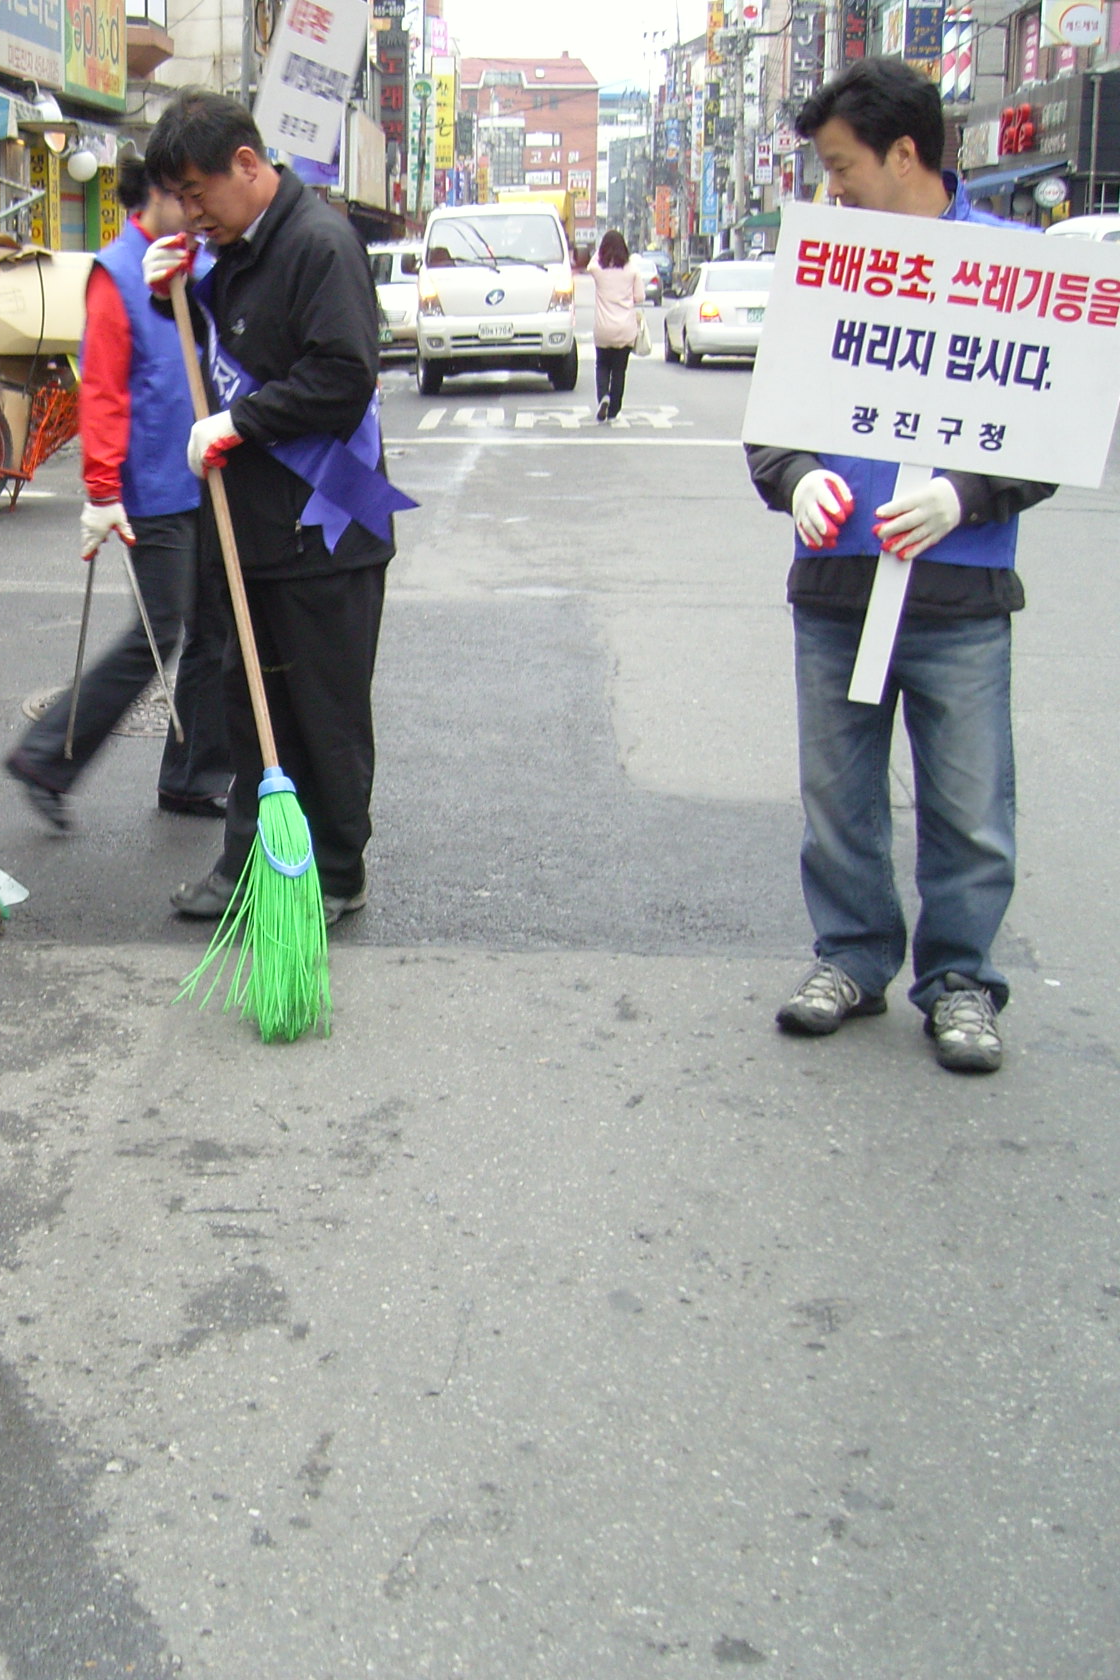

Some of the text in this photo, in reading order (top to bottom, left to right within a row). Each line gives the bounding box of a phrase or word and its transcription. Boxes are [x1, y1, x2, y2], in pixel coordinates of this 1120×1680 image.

[795, 239, 1120, 326] 담배꽁초, 쓰레기등을
[831, 319, 1051, 391] 버리지 맙시다.
